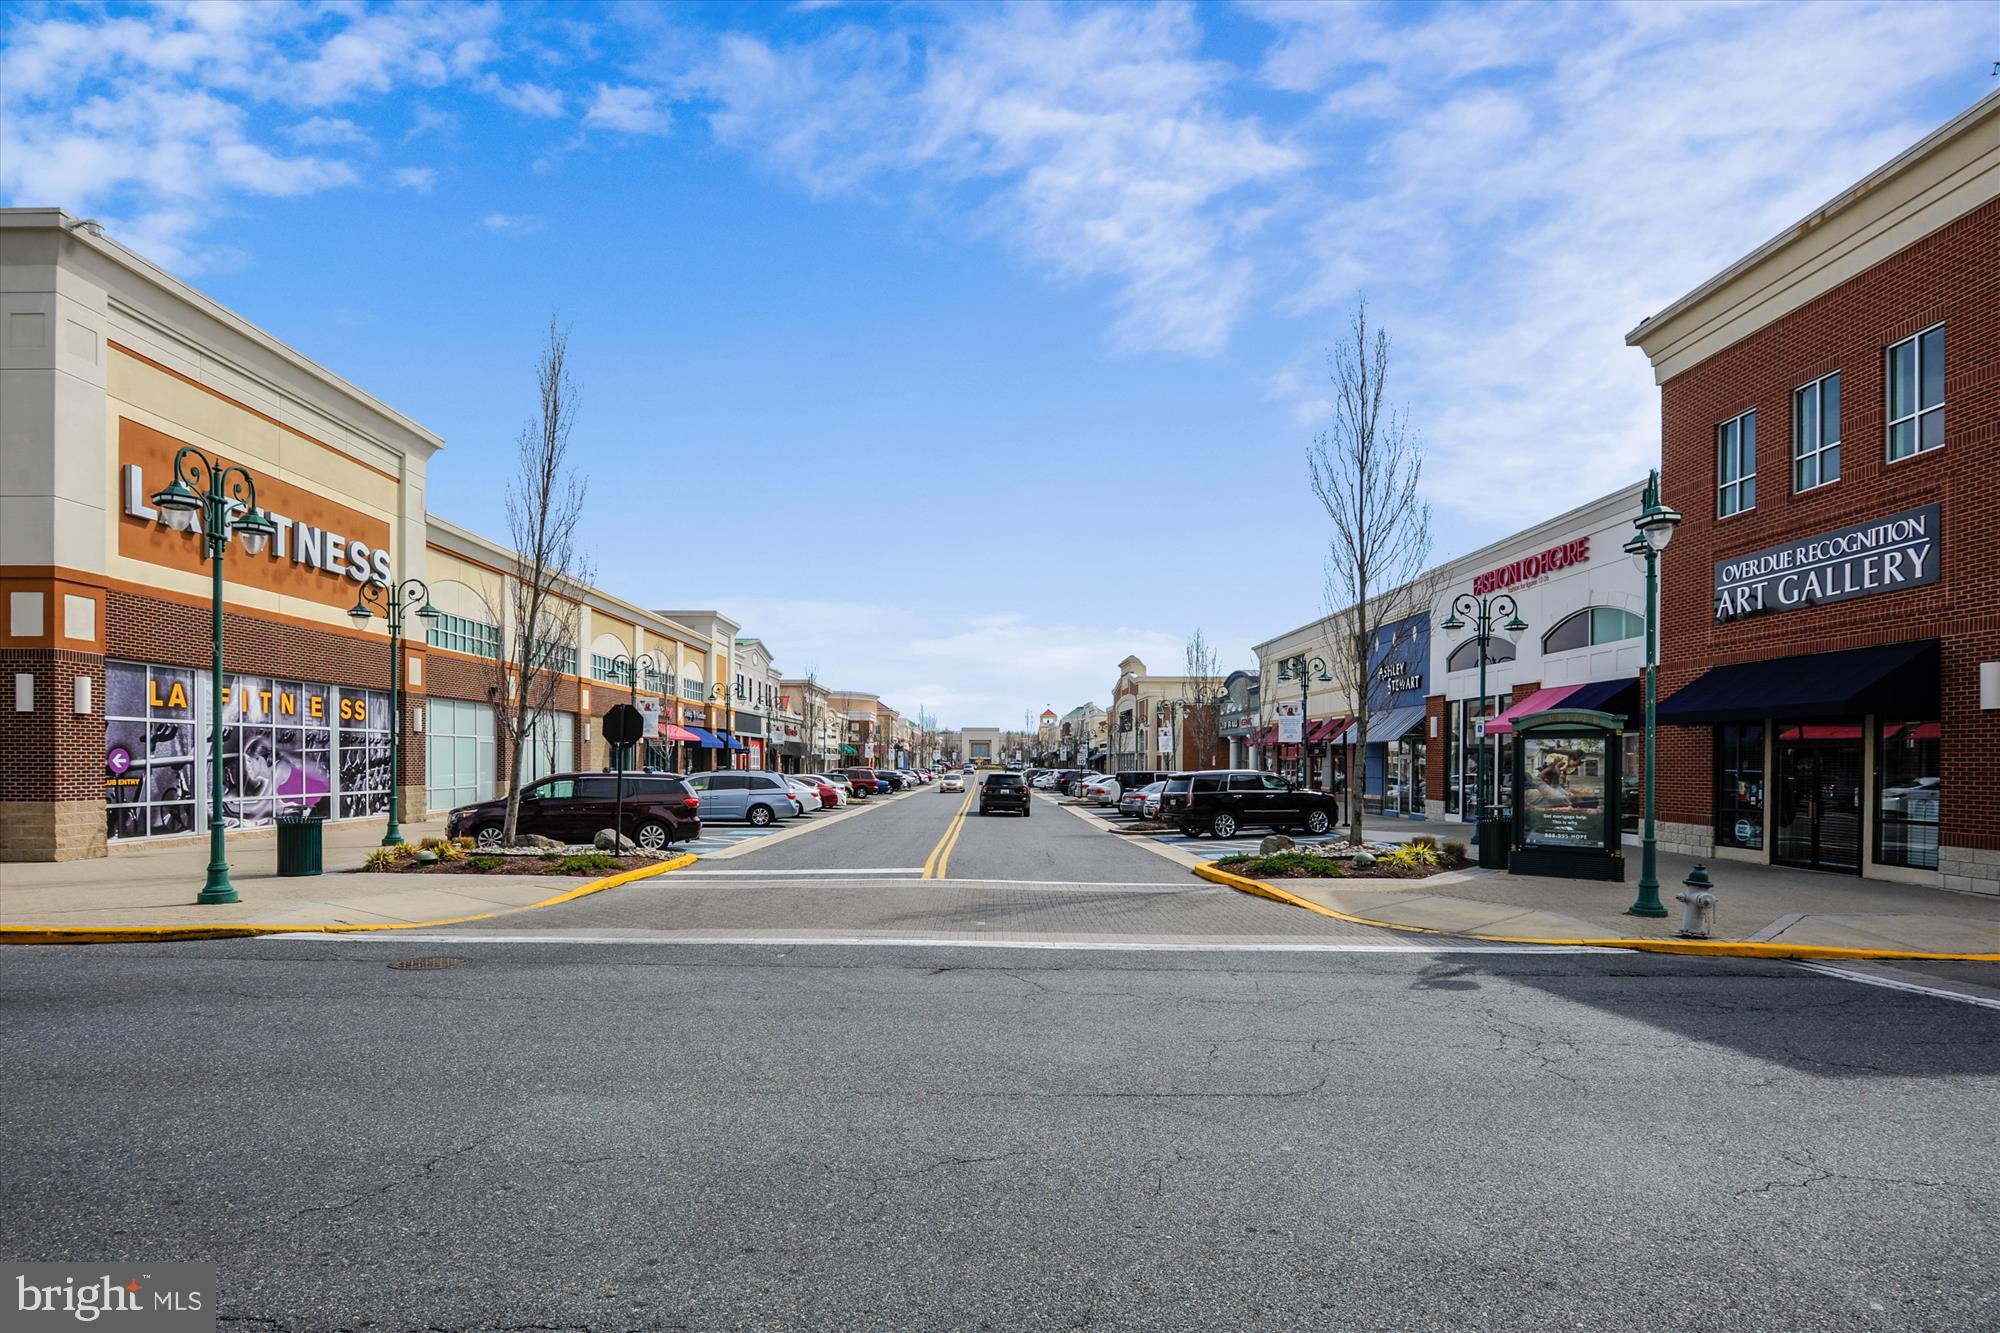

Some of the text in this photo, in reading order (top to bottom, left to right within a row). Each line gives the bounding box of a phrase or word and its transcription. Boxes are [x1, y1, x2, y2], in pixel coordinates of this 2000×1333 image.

[203, 490, 391, 588] FTNESS
[1473, 536, 1590, 596] FASHION TO FIGURE
[1723, 515, 1927, 583] OVERDUE RECOGNITION
[1716, 544, 1932, 618] ART GALLERY
[150, 680, 187, 709] LA
[1378, 662, 1405, 681] ASHLEY
[1387, 675, 1420, 695] STEWART
